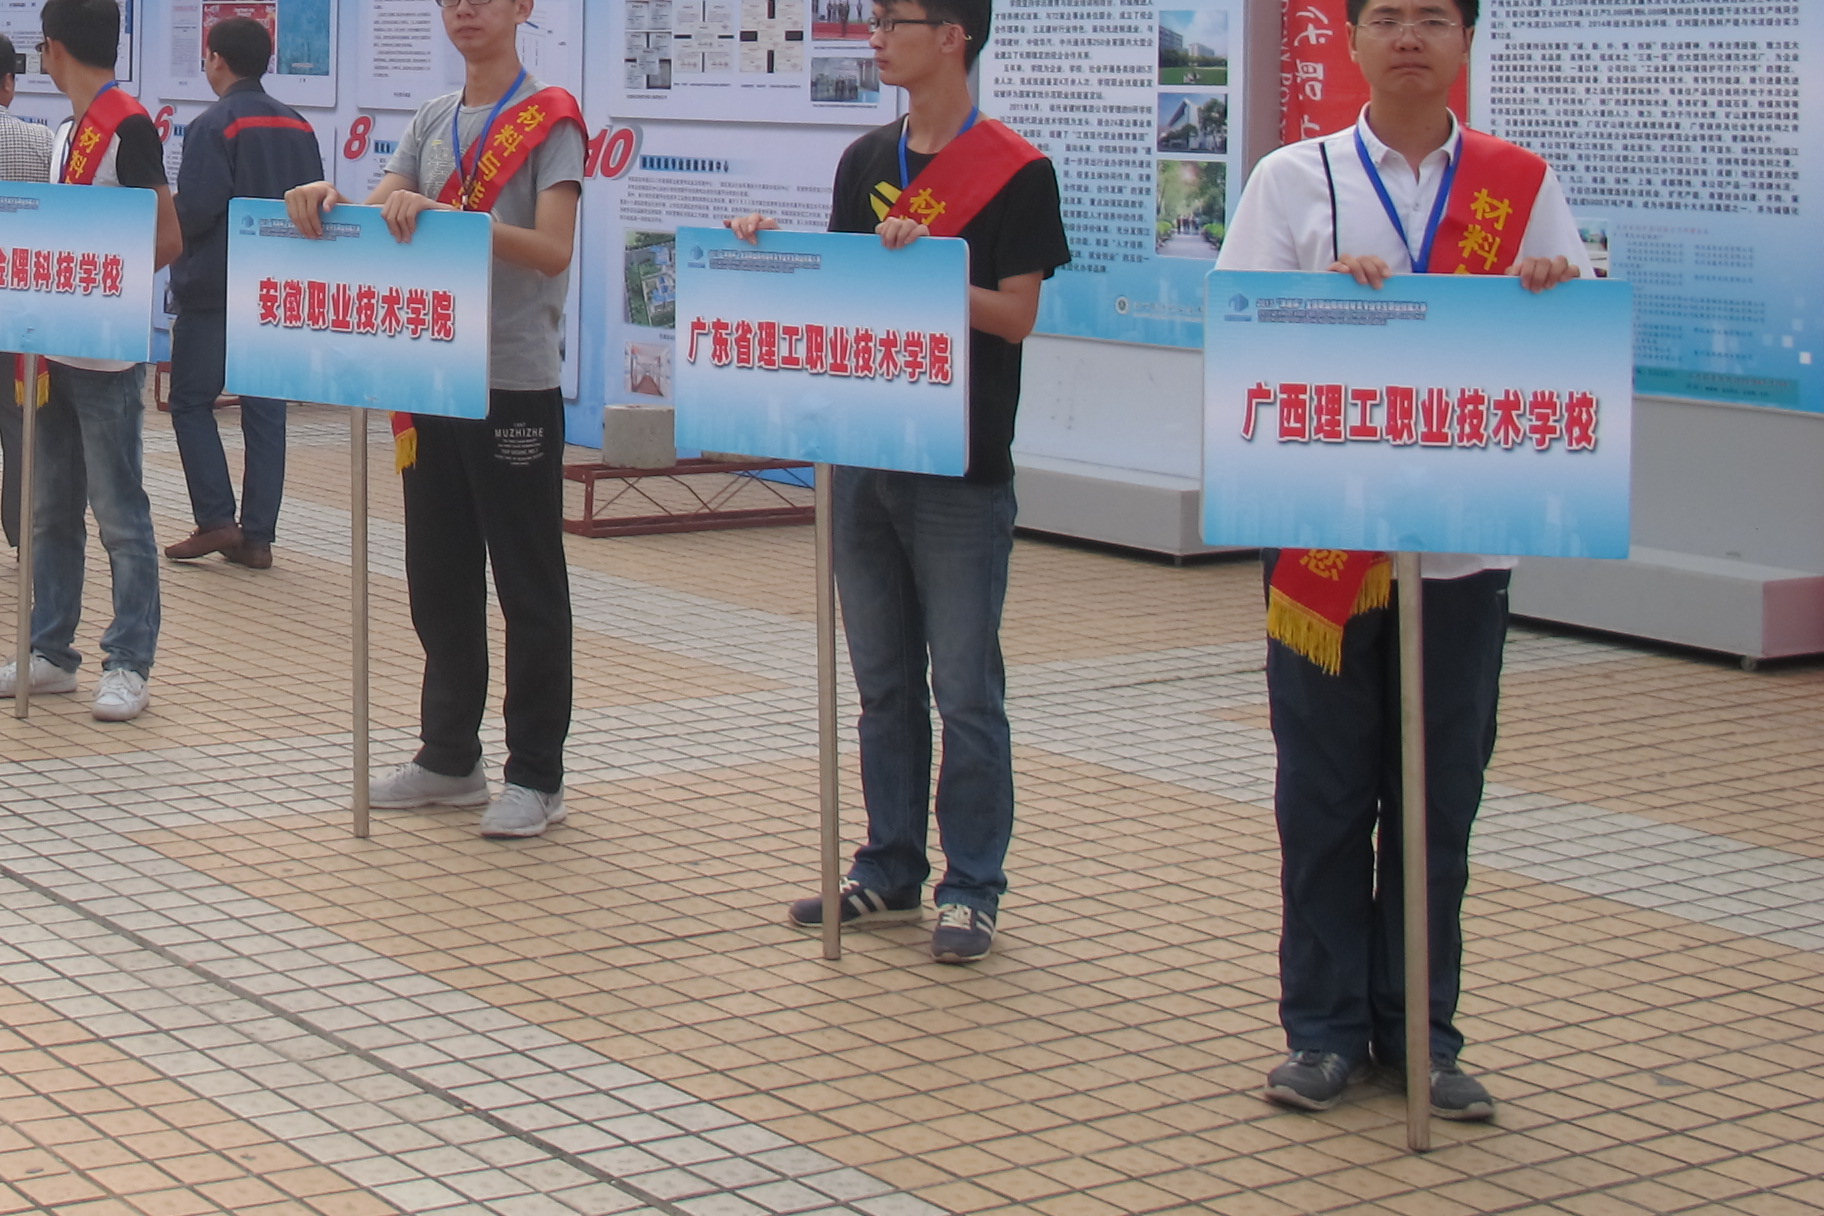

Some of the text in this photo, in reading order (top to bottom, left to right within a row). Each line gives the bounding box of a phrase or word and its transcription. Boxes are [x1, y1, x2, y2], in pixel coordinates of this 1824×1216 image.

[65, 125, 102, 184] 材料
[343, 114, 374, 161] 8
[1455, 188, 1514, 273] 材料
[258, 277, 456, 341] 安徽职业技术学院
[687, 316, 953, 384] 广东省理工职业技术学院
[1241, 381, 1599, 452] 广西理工职业技术学校
